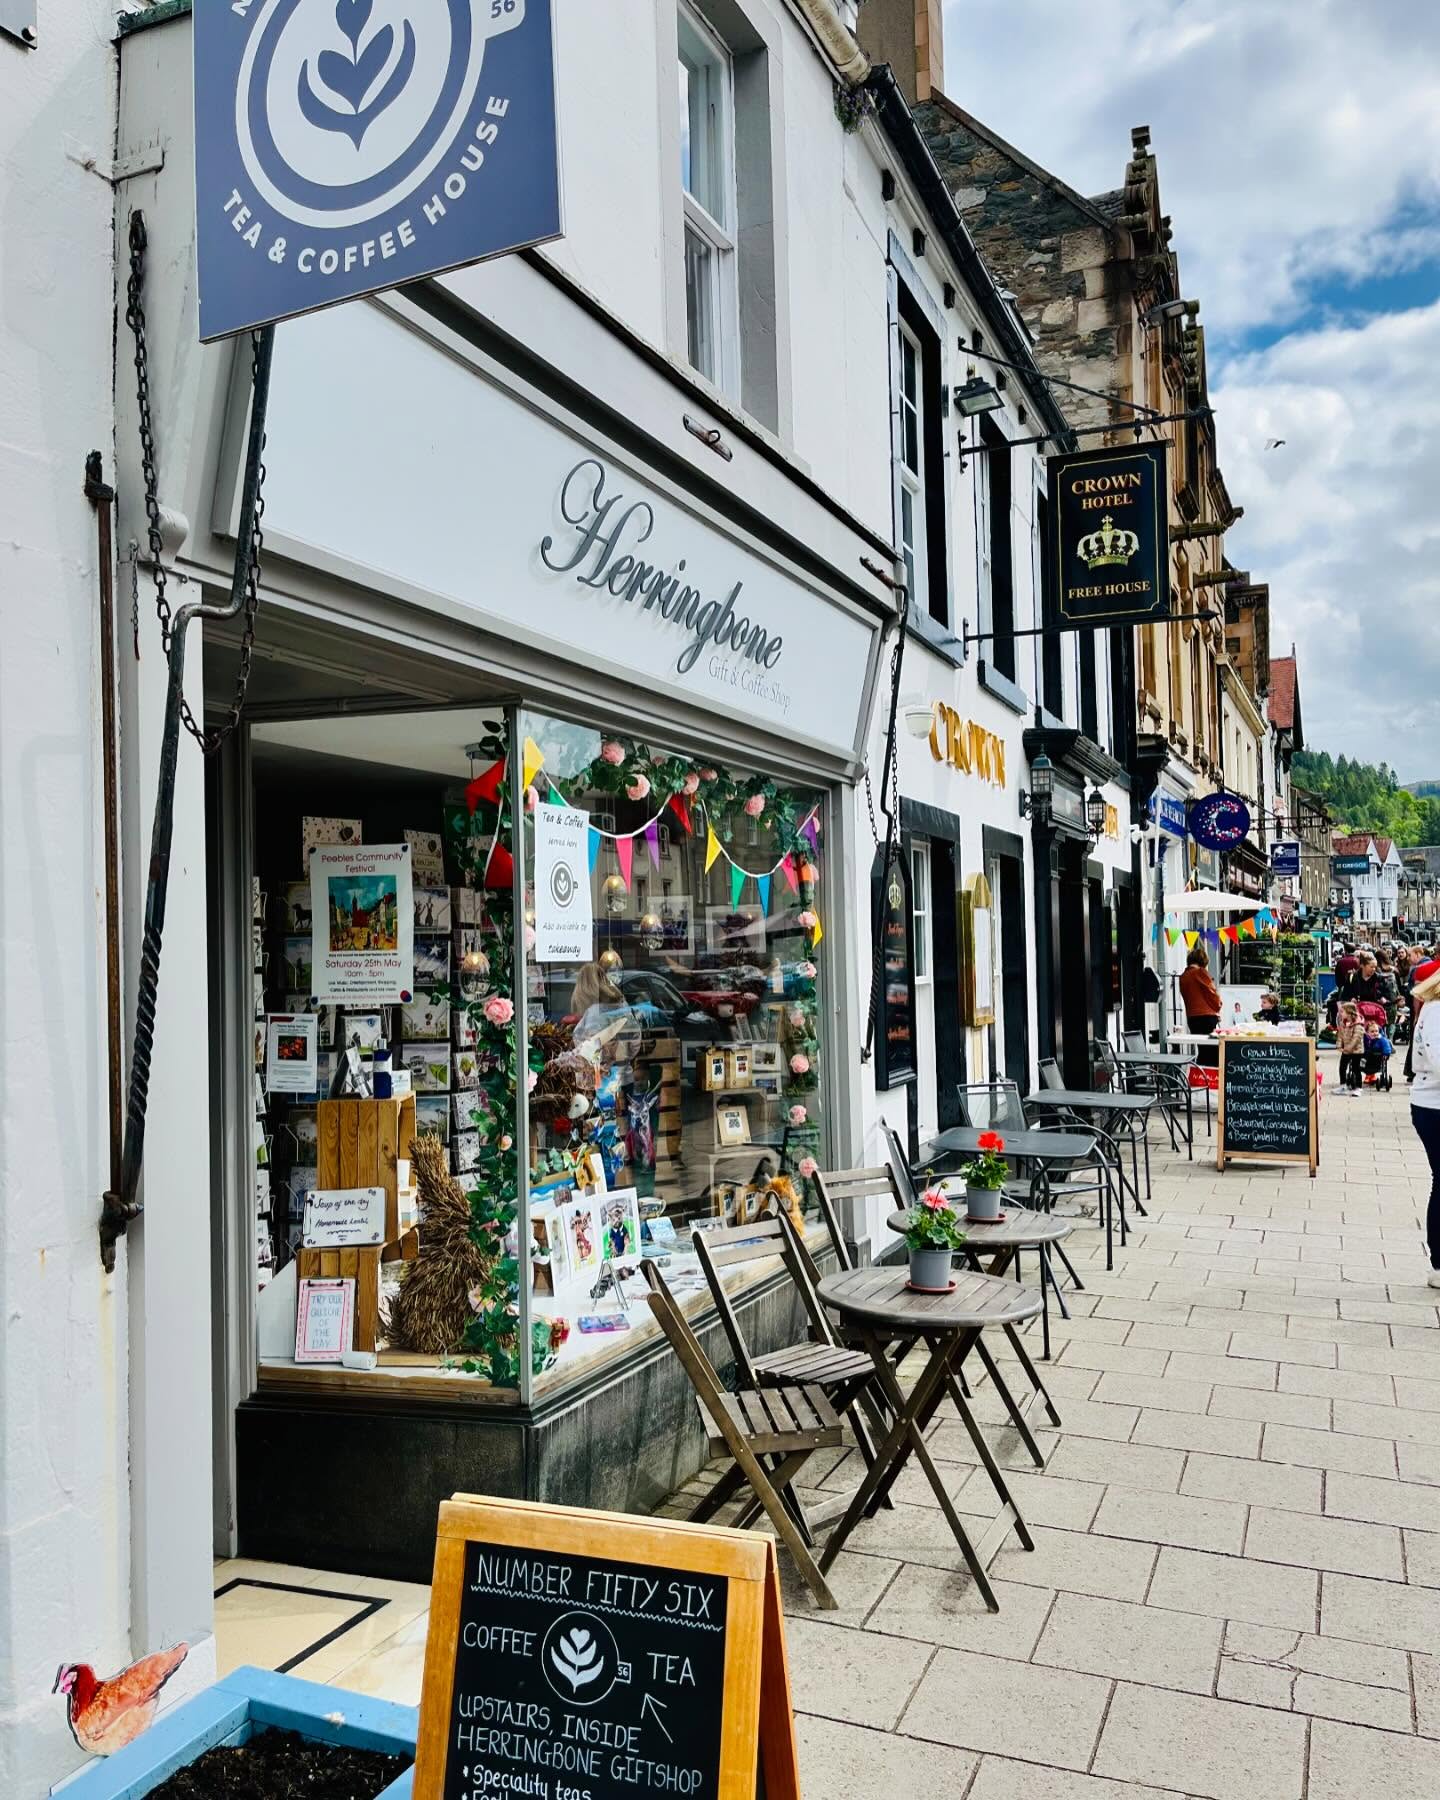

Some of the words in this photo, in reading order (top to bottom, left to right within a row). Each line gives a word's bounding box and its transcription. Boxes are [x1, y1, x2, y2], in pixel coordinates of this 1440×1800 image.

[490, 0, 515, 18] 56
[222, 188, 263, 249] TEA
[267, 236, 287, 264] &
[297, 219, 416, 275] COFFEE
[422, 95, 511, 226] HOUSE
[1071, 472, 1142, 495] CROWN
[1082, 493, 1133, 510] HOTEL
[541, 459, 783, 674] Herringbone
[1068, 585, 1103, 600] FREE
[1104, 580, 1151, 596] HOUSE
[709, 655, 728, 682] Gift
[928, 701, 1006, 790] CROWN
[542, 811, 555, 823] Tea
[556, 814, 563, 824] &
[563, 815, 584, 829] Coffee
[321, 854, 354, 863] Peebles
[355, 852, 403, 862] Community
[345, 864, 375, 873] Festival
[325, 959, 362, 968] Saturday
[364, 958, 382, 967] 25th
[383, 958, 402, 968] May
[313, 1197, 333, 1211] Soup
[333, 1200, 342, 1211] of
[477, 1553, 573, 1596] NUMBER
[586, 1569, 660, 1609] FIFTY
[664, 1580, 715, 1619] SIX
[463, 1622, 537, 1657] COFFEE
[617, 1665, 630, 1677] 56
[646, 1652, 696, 1686] TEA
[458, 1693, 555, 1736] UPSTAIRS,
[561, 1715, 642, 1753] INSIDE
[457, 1723, 604, 1778] HERRINGBONE
[610, 1755, 702, 1794] GIFTSHOP
[472, 1764, 549, 1800] Speciality
[555, 1780, 592, 1800] teas
